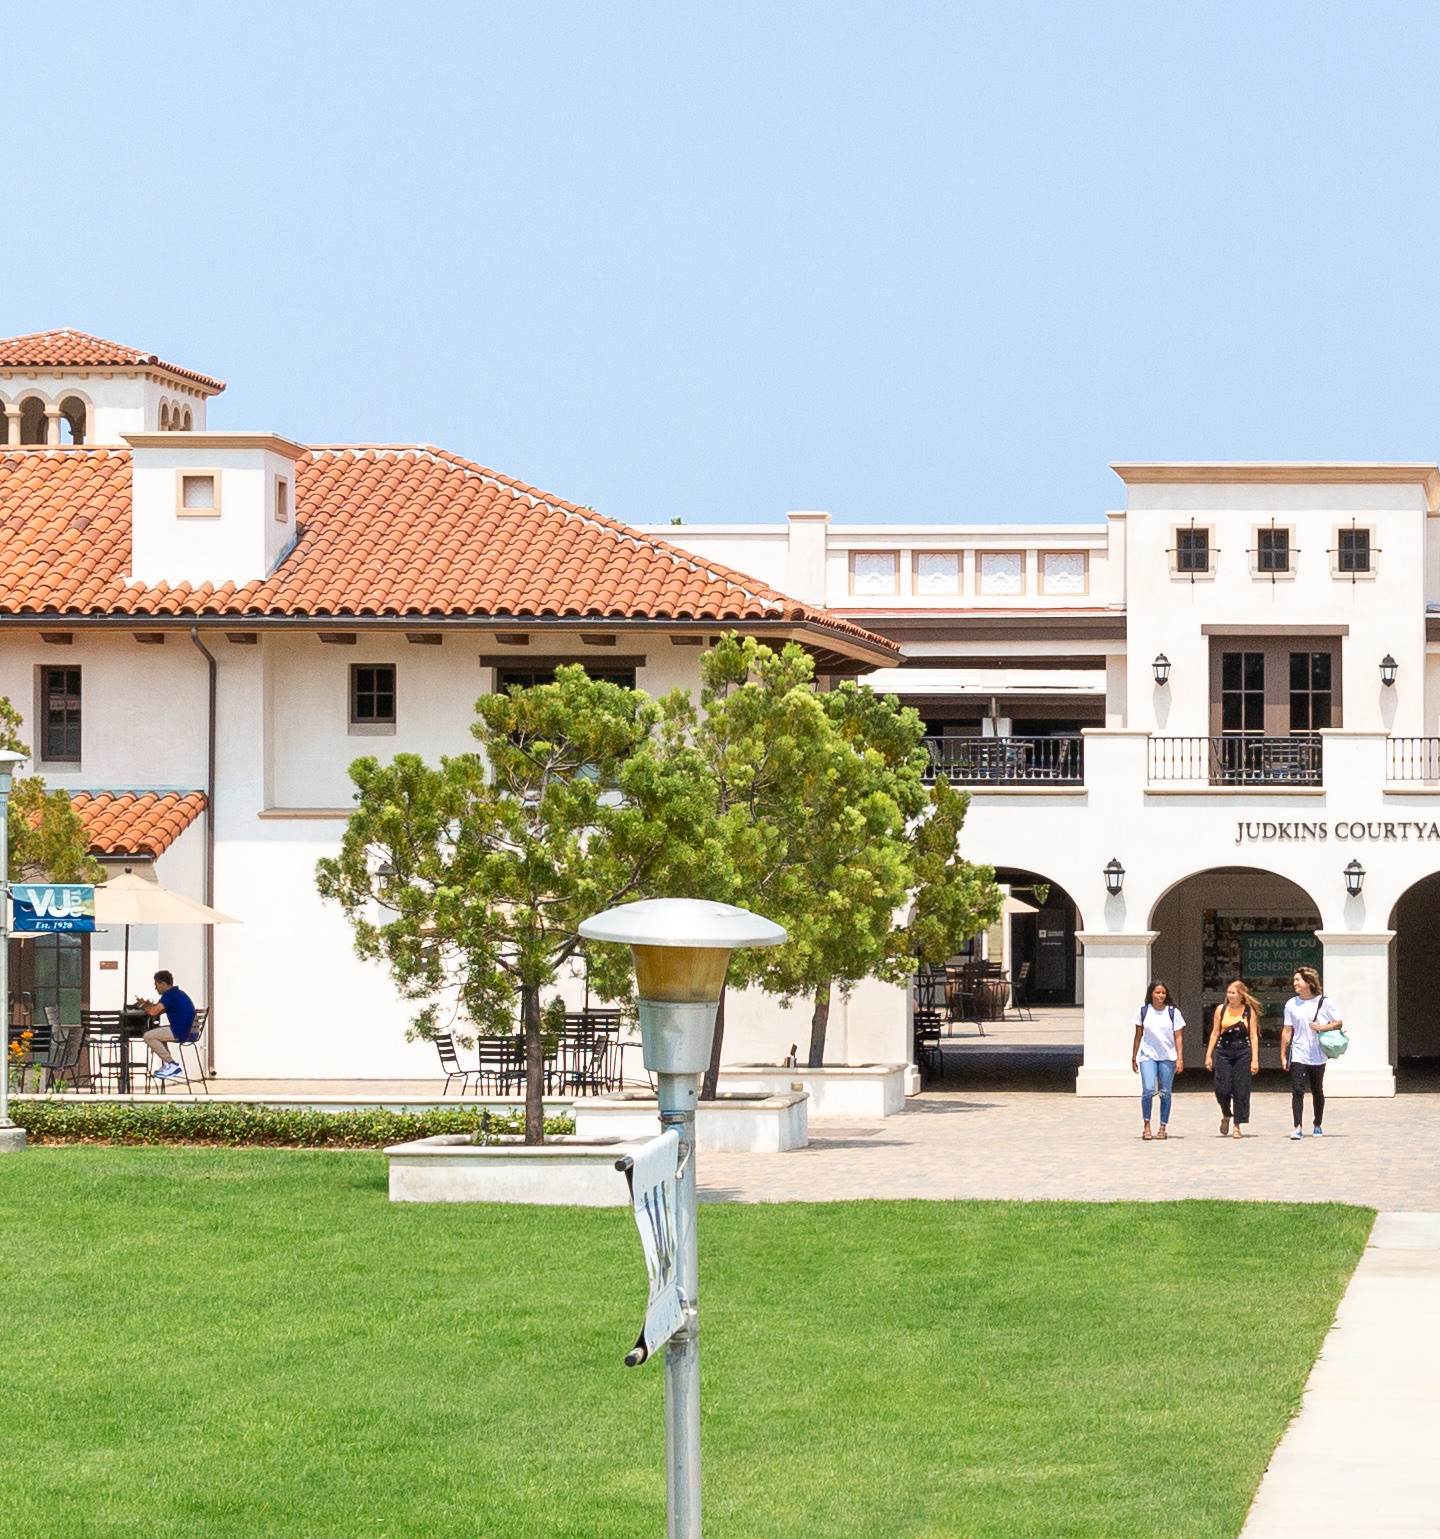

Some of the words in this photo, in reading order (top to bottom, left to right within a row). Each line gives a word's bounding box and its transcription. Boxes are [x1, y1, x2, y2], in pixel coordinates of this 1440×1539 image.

[1235, 821, 1328, 844] JUDKINS
[26, 889, 71, 917] VU
[1248, 939, 1287, 948] THANK
[1292, 939, 1317, 948] YOU
[1248, 950, 1269, 959] FOR
[1272, 950, 1301, 959] YOUR
